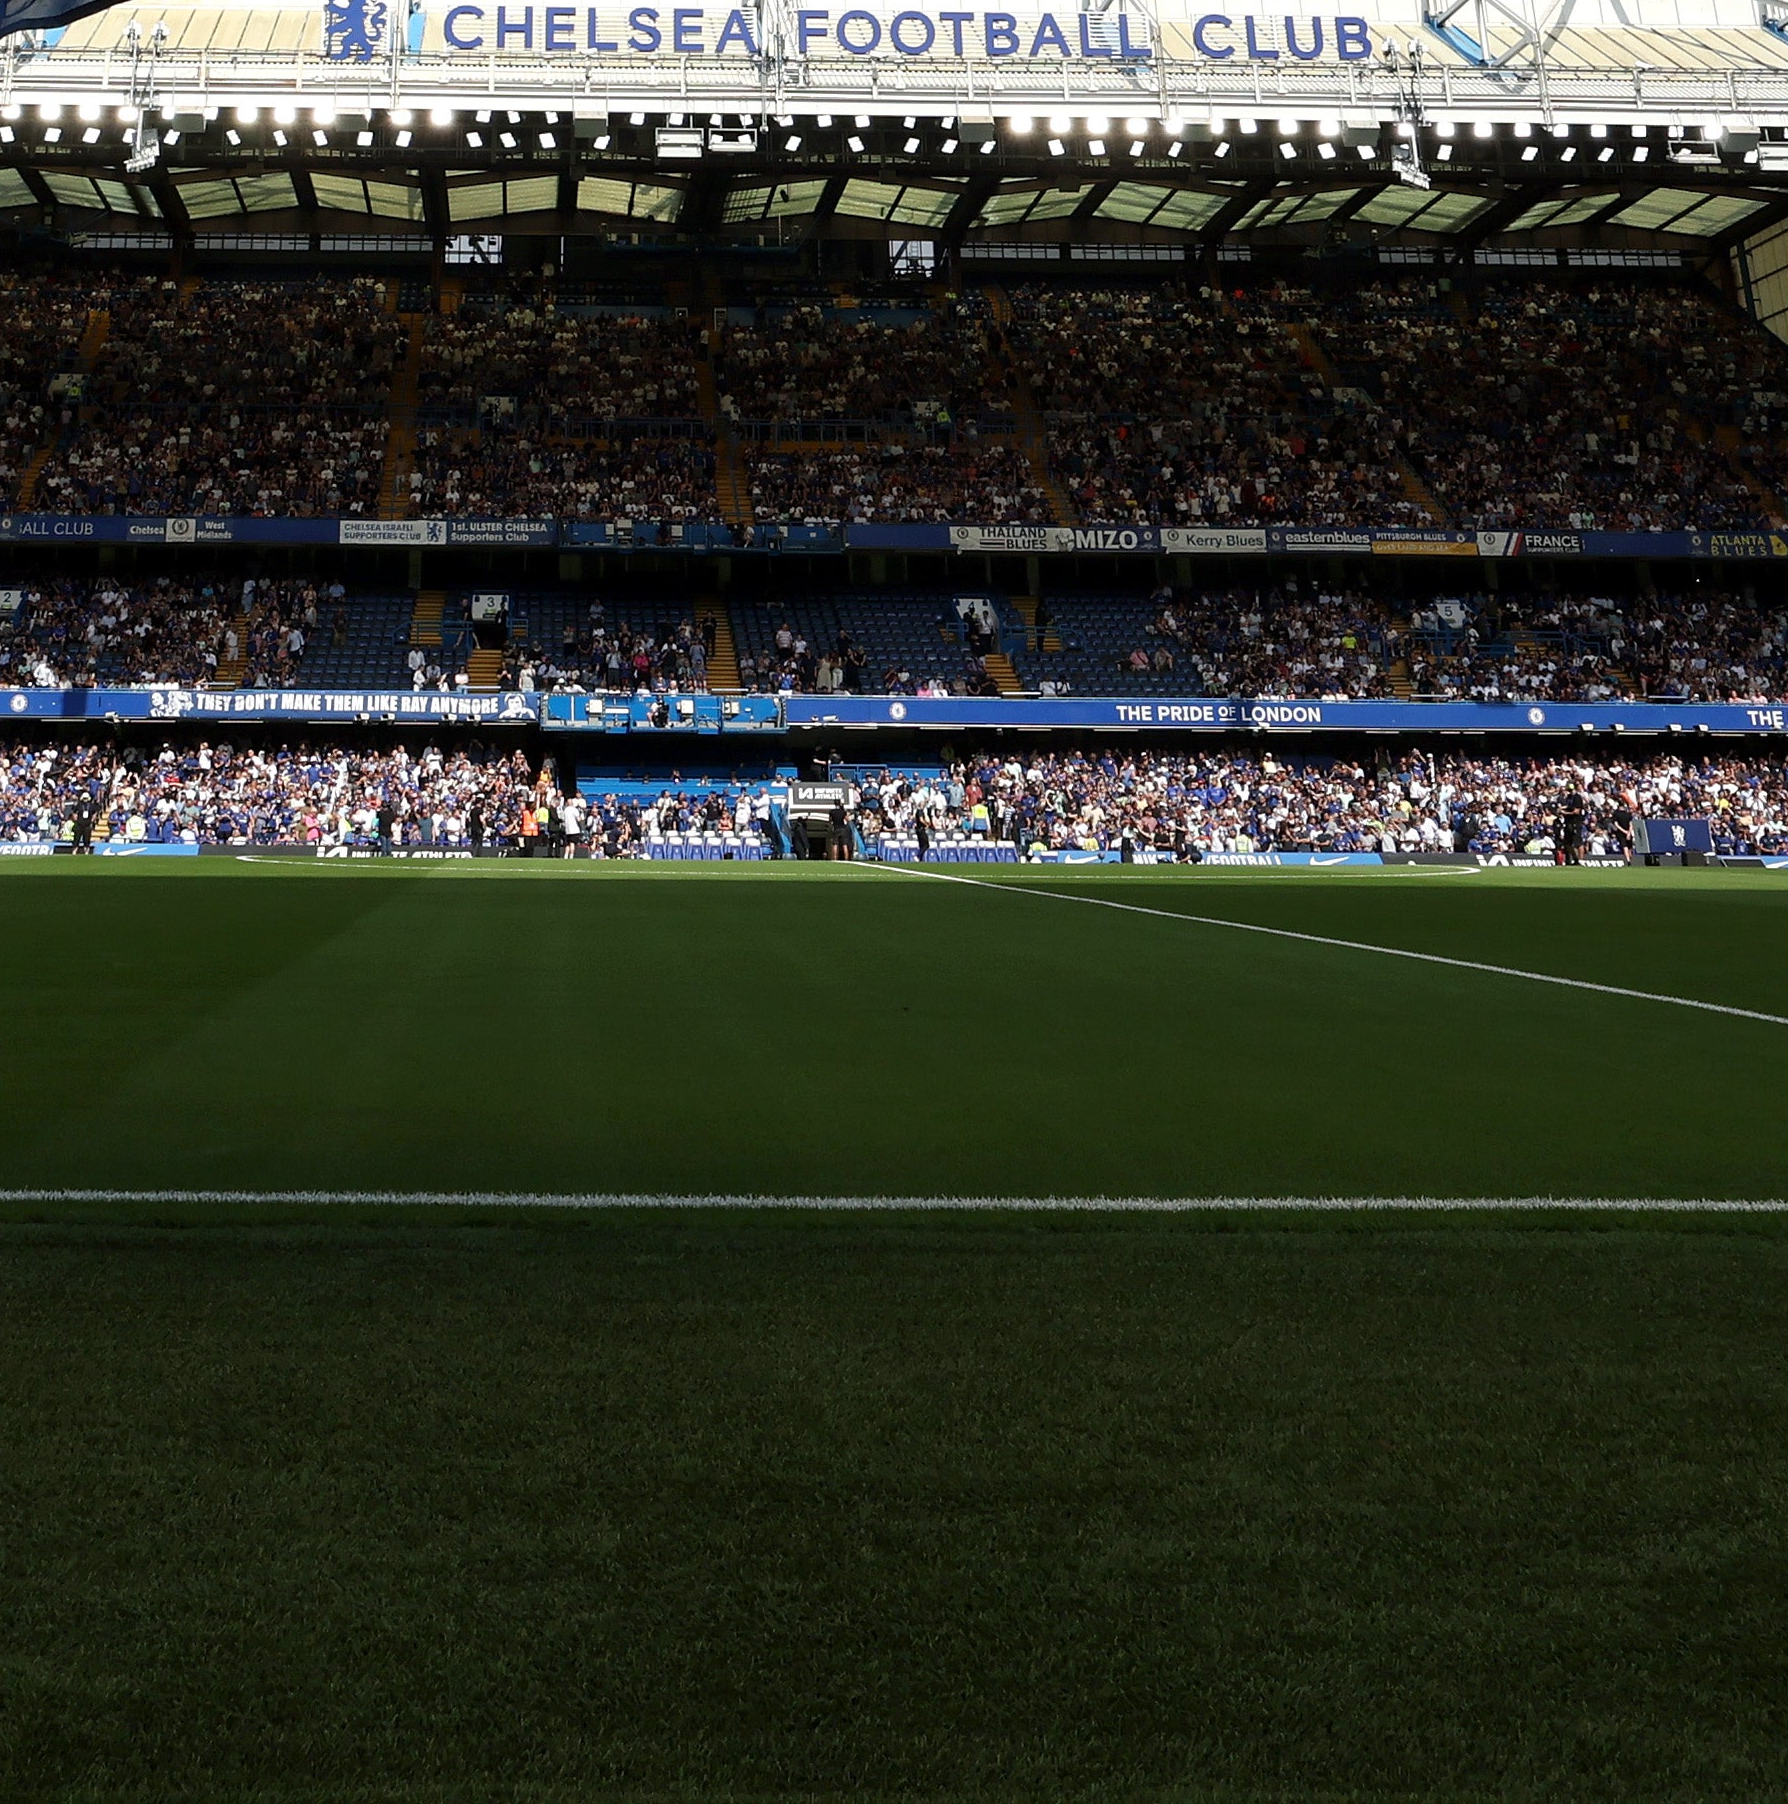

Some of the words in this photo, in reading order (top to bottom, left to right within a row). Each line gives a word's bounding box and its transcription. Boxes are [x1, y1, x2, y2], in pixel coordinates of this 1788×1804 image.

[444, 4, 758, 53] CHELSEA
[797, 9, 1153, 58] FOOTBALL
[1193, 14, 1373, 60] CLUB
[54, 522, 93, 535] CLUB
[130, 525, 164, 535] Chelsea
[205, 521, 226, 530] West
[470, 523, 503, 532] ULSTER
[505, 523, 547, 532] CHELSEA
[197, 530, 232, 539] Midlands
[344, 532, 398, 540] SUPPORTERS
[400, 532, 421, 540] CLUB
[451, 532, 504, 542] Supporters
[506, 532, 529, 542] Club
[980, 528, 1046, 538] THAILAND
[1285, 531, 1370, 544] easternblues
[1376, 532, 1421, 541] PITTSBURGH
[1424, 533, 1447, 541] BLUES
[1007, 539, 1047, 550] BLUES
[1075, 530, 1138, 549] MIZO
[1187, 534, 1222, 547] Kerry
[1226, 535, 1262, 546] Blues
[1525, 535, 1580, 547] FRANCE
[1711, 535, 1766, 545] ATLANTA
[1712, 546, 1768, 556] BLUES
[196, 694, 231, 712] THEY
[235, 694, 278, 711] DON'T
[281, 694, 321, 711] MAKE
[325, 695, 363, 711] THEM
[367, 696, 398, 712] LIKE
[401, 696, 428, 713] RAY
[430, 696, 499, 714] ANYMORE
[1116, 706, 1152, 721] THE
[1158, 706, 1214, 721] PRIDE
[1218, 706, 1236, 721] OF
[1241, 706, 1321, 722] LONDON
[1747, 711, 1784, 727] THE
